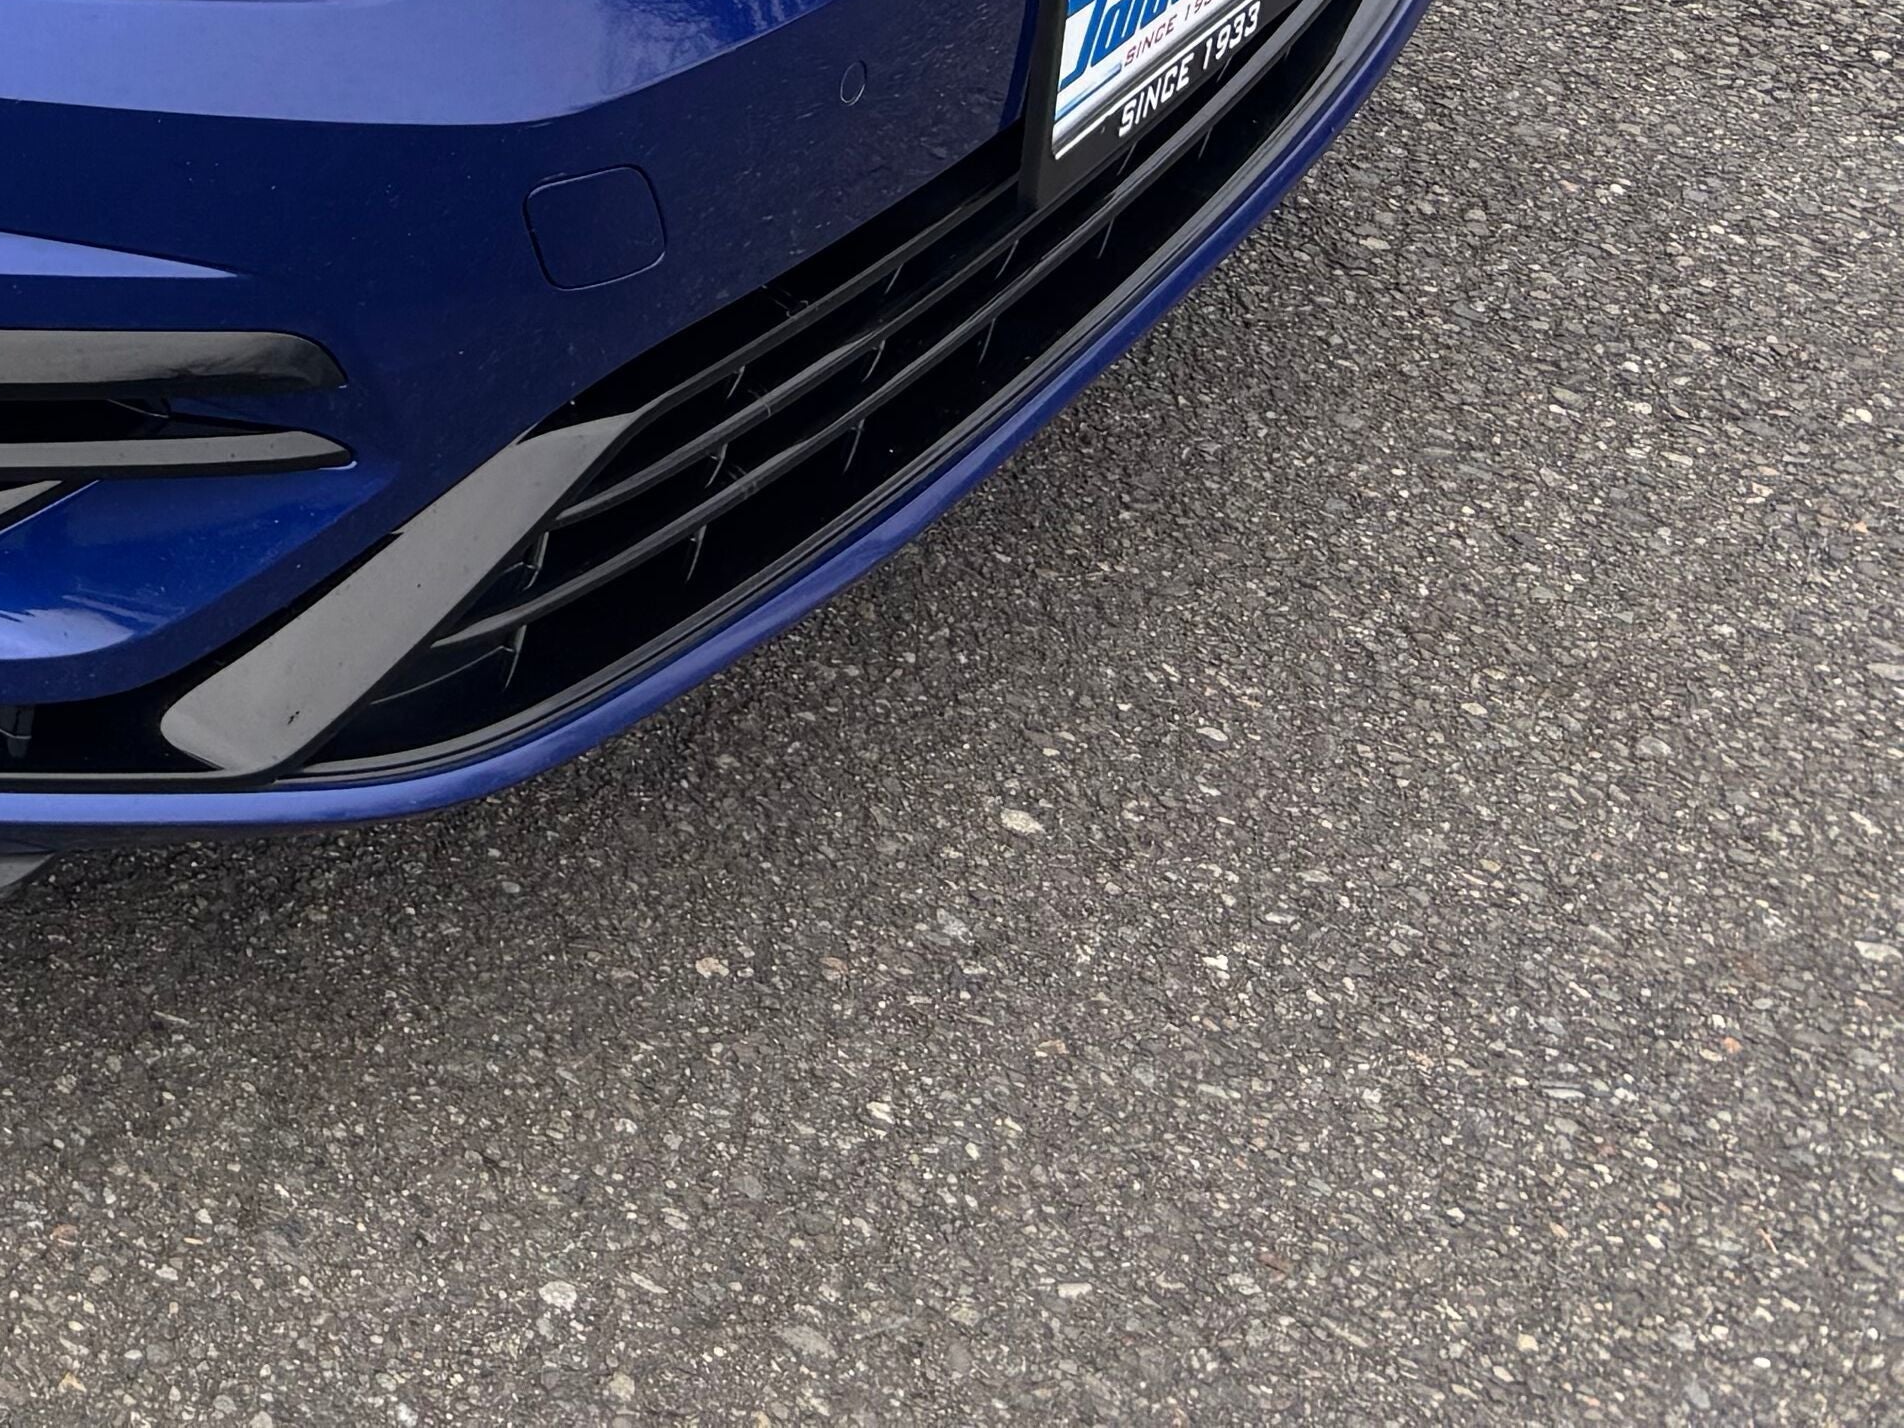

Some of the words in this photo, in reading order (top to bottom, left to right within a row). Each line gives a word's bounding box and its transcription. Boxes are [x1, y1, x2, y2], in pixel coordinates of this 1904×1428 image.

[1118, 51, 1195, 138] SINCE
[1202, 0, 1262, 71] 1933
[1124, 14, 1178, 67] SINCE
